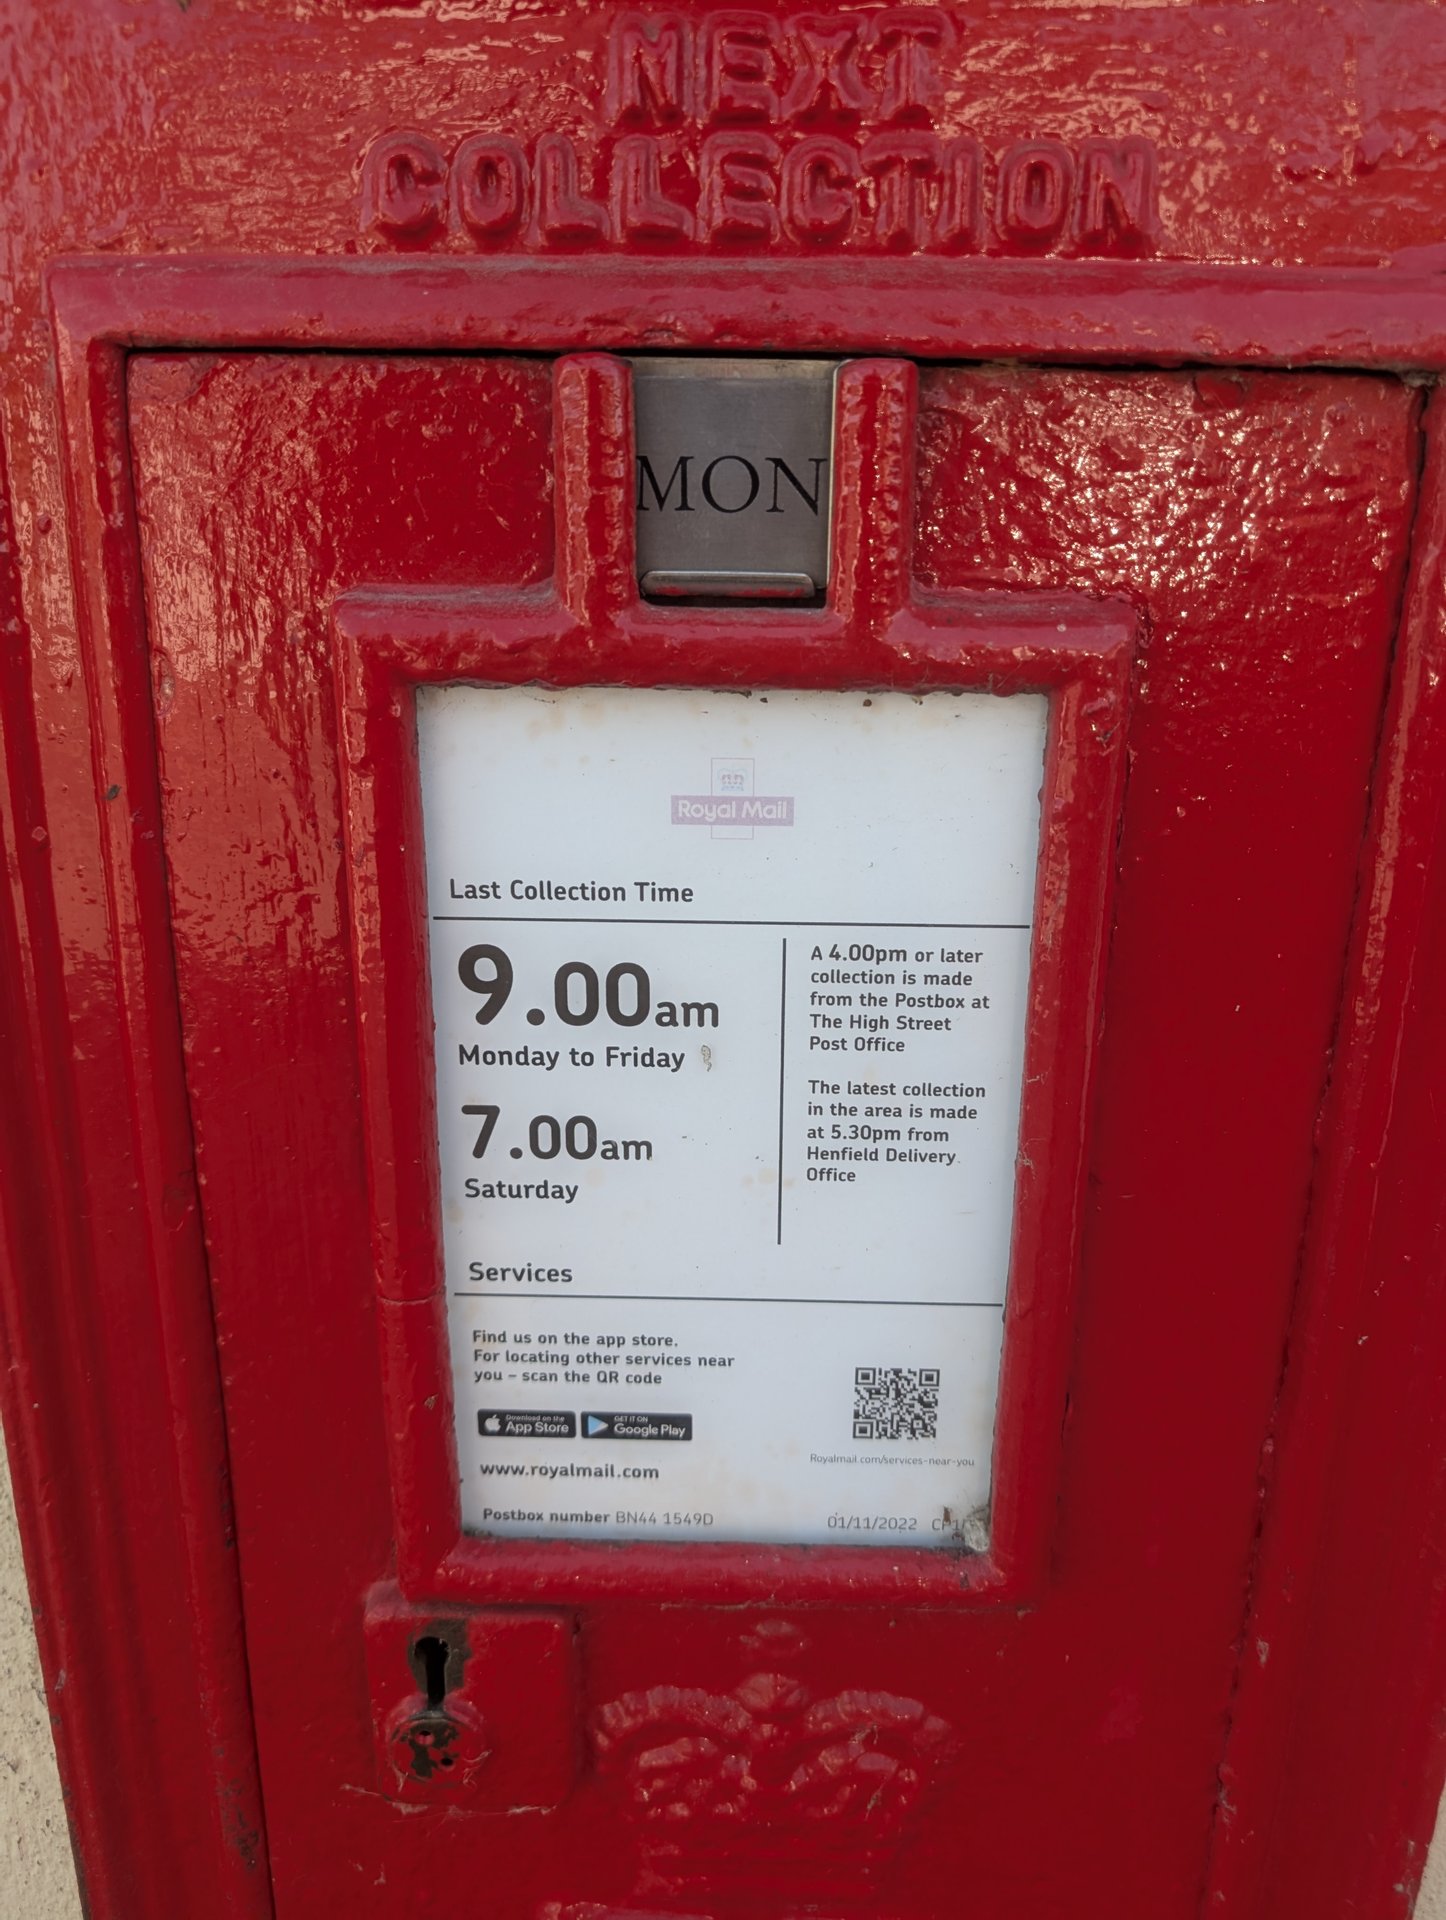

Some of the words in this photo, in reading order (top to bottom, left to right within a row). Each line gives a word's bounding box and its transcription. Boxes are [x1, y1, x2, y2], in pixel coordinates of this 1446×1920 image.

[608, 13, 958, 126] NEXT
[362, 132, 1158, 248] COLLECTION
[636, 455, 828, 516] MON
[678, 800, 736, 822] Royal
[741, 801, 787, 819] Mail
[450, 879, 501, 899] Last
[511, 880, 625, 901] Collection
[634, 882, 693, 902] Time
[811, 946, 822, 960] A
[829, 944, 907, 965] 4.00pm
[915, 951, 934, 962] or
[941, 948, 983, 963] later
[458, 944, 718, 1027] 9.00am
[811, 969, 894, 984] collection
[903, 970, 916, 984] is
[924, 971, 972, 985] made
[810, 991, 852, 1006] from
[859, 993, 888, 1007] the
[896, 993, 964, 1008] Postbox
[972, 996, 989, 1009] at
[810, 1014, 842, 1028] The
[850, 1015, 889, 1032] High
[896, 1016, 951, 1030] Street
[810, 1036, 847, 1050] Post
[855, 1037, 905, 1052] Office
[459, 1044, 559, 1071] Monday
[569, 1048, 594, 1066] to
[606, 1046, 685, 1072] Friday
[808, 1080, 840, 1094] The
[848, 1081, 896, 1095] latest
[903, 1083, 985, 1097] collection
[808, 1102, 823, 1115] in
[830, 1103, 857, 1116] the
[865, 1107, 902, 1117] area
[910, 1104, 922, 1118] is
[930, 1105, 977, 1119] made
[461, 1105, 652, 1160] 7.00am
[807, 1127, 824, 1139] at
[831, 1124, 900, 1143] 5.30pm
[908, 1127, 948, 1141] from
[808, 1146, 878, 1161] Henfield
[886, 1148, 956, 1166] Delivery
[807, 1168, 855, 1181] Office
[465, 1178, 578, 1203] Saturday
[469, 1262, 572, 1282] Services
[473, 1330, 507, 1343] Find
[514, 1334, 531, 1343] us
[538, 1335, 557, 1344] on
[564, 1333, 589, 1344] the
[597, 1336, 625, 1348] app
[632, 1335, 677, 1346] store.
[474, 1349, 500, 1362] For
[506, 1350, 569, 1366] locating
[576, 1352, 619, 1364] other
[626, 1353, 691, 1365] services
[698, 1357, 734, 1366] near
[474, 1371, 502, 1383] you
[522, 1372, 558, 1382] scan
[565, 1371, 590, 1382] the
[597, 1371, 618, 1383] QR
[626, 1372, 661, 1384] code
[506, 1421, 534, 1434] App
[535, 1422, 569, 1433] Store
[614, 1424, 658, 1436] Google
[661, 1425, 686, 1438] Play
[810, 1453, 975, 1466] Royalmail.com/services-near-you
[480, 1463, 659, 1479] www.royalmail.com
[482, 1508, 543, 1522] Postbox
[550, 1511, 610, 1524] number
[616, 1511, 656, 1526] BN44
[664, 1513, 713, 1527] 1549D
[828, 1516, 917, 1529] 01/11/2022
